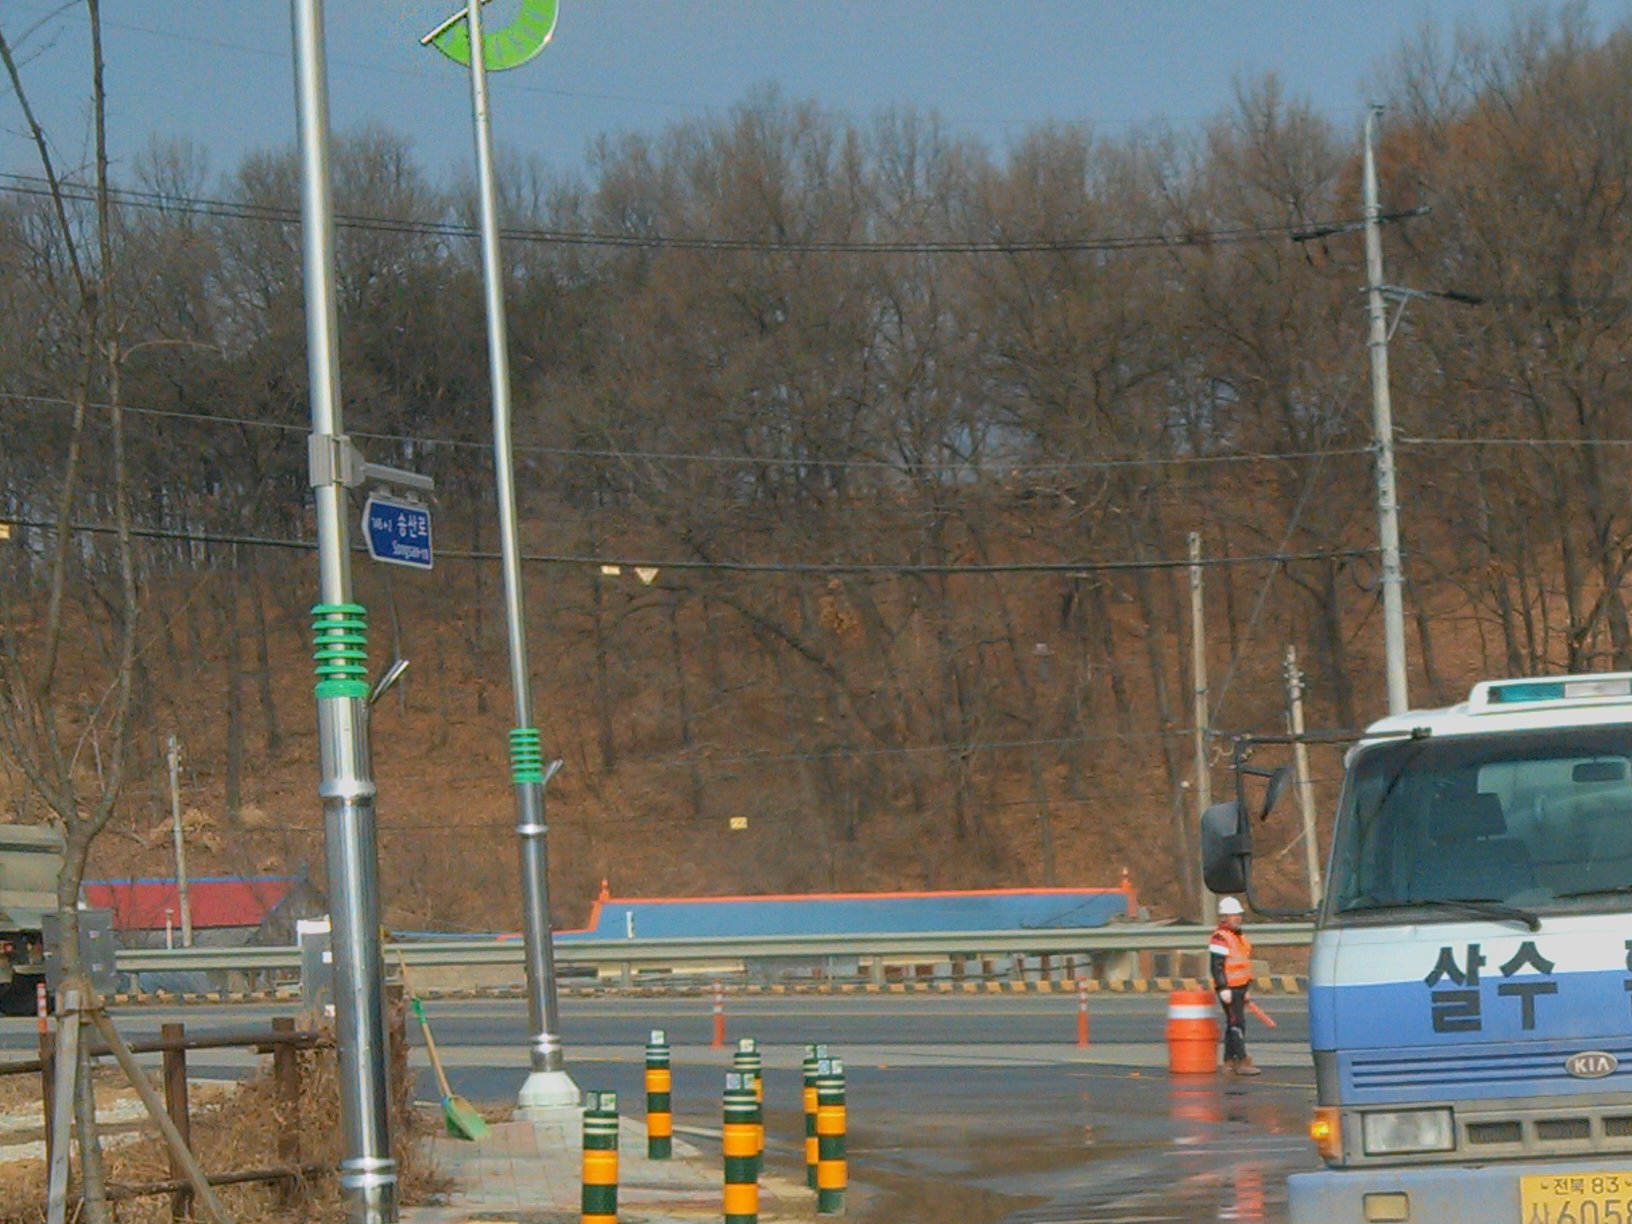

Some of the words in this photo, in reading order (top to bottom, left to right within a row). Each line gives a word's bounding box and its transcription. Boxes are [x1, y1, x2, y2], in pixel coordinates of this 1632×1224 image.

[397, 512, 428, 538] 송산로
[1424, 940, 1558, 1033] 살수
[1553, 1178, 1585, 1195] 전북
[1591, 1176, 1620, 1194] 83
